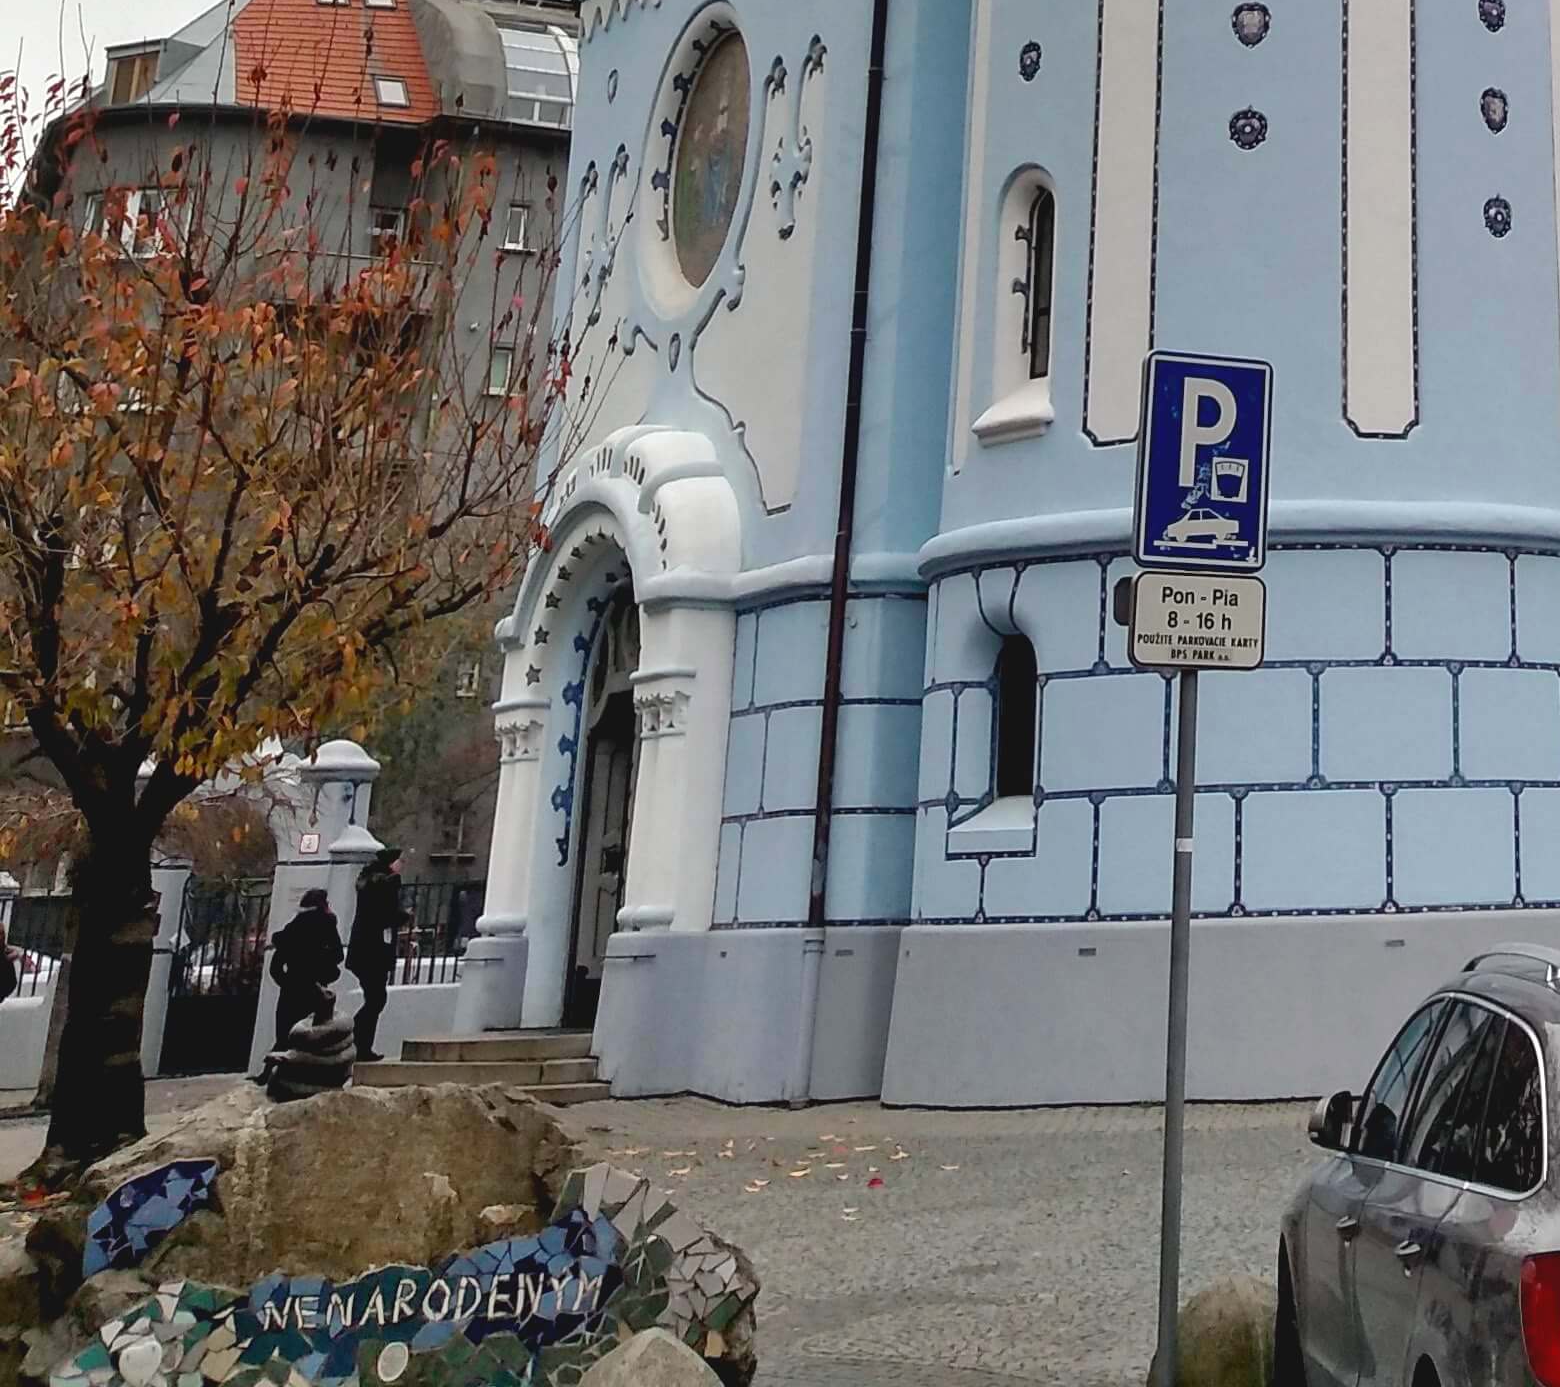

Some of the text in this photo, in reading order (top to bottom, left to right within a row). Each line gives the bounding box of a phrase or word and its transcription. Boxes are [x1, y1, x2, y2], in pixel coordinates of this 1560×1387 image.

[1178, 376, 1238, 487] P
[1161, 586, 1195, 605] Pon
[1212, 588, 1239, 607] Pia
[1167, 611, 1178, 628] 8
[1196, 612, 1215, 630] 16
[1221, 613, 1232, 631] h
[1137, 631, 1259, 648] POUŽITE PARKOVACIE KARTY
[1171, 649, 1187, 659] BPS
[1192, 649, 1215, 660] PARK
